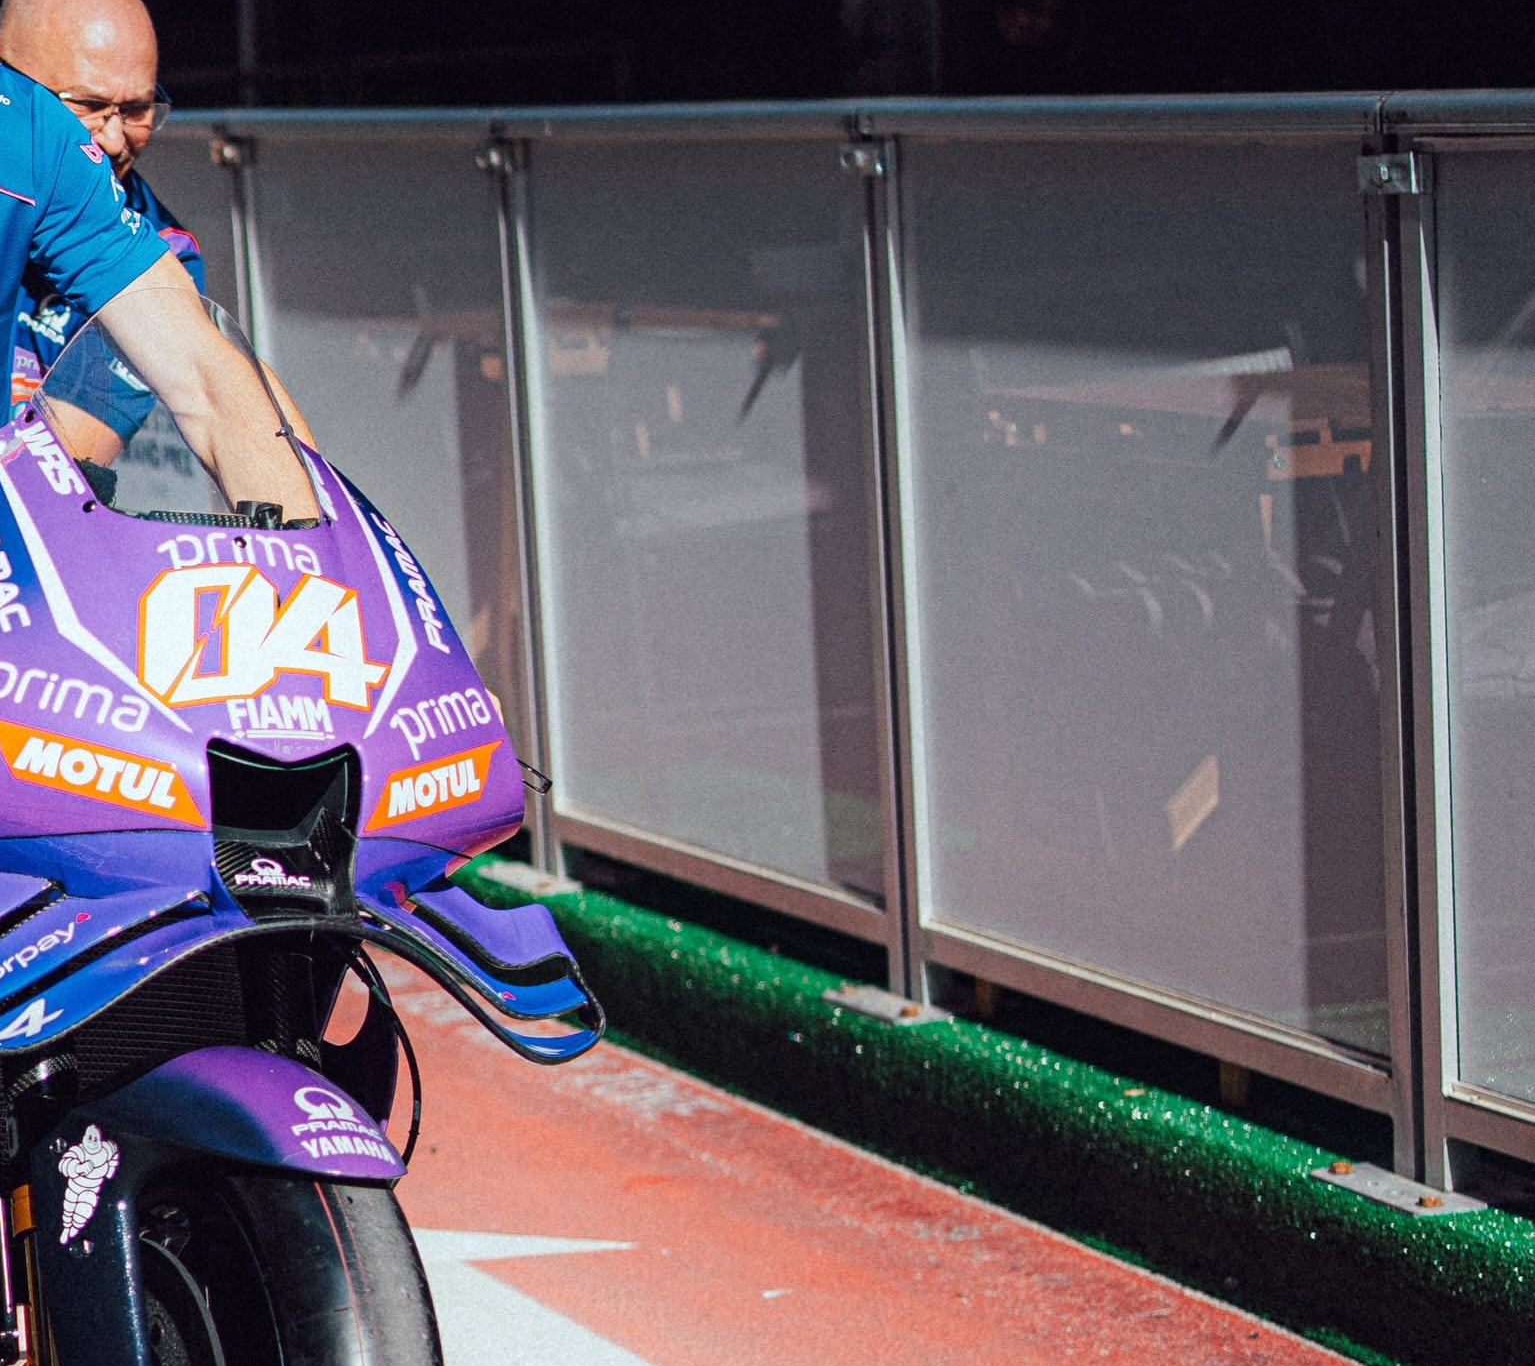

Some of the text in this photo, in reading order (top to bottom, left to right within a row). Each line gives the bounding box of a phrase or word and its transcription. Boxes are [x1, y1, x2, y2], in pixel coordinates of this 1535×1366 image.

[15, 421, 86, 496] WRS
[157, 532, 322, 577] prima
[370, 512, 451, 655] PRAMAC
[135, 561, 393, 713] 04
[226, 695, 335, 734] FIAMM
[389, 687, 491, 761] prima
[13, 736, 177, 809] MOTUL
[388, 757, 481, 818] MOTUL
[234, 873, 312, 887] PRAMAC
[291, 1120, 383, 1141] PRAMAC
[301, 1135, 396, 1165] YAMAHA
